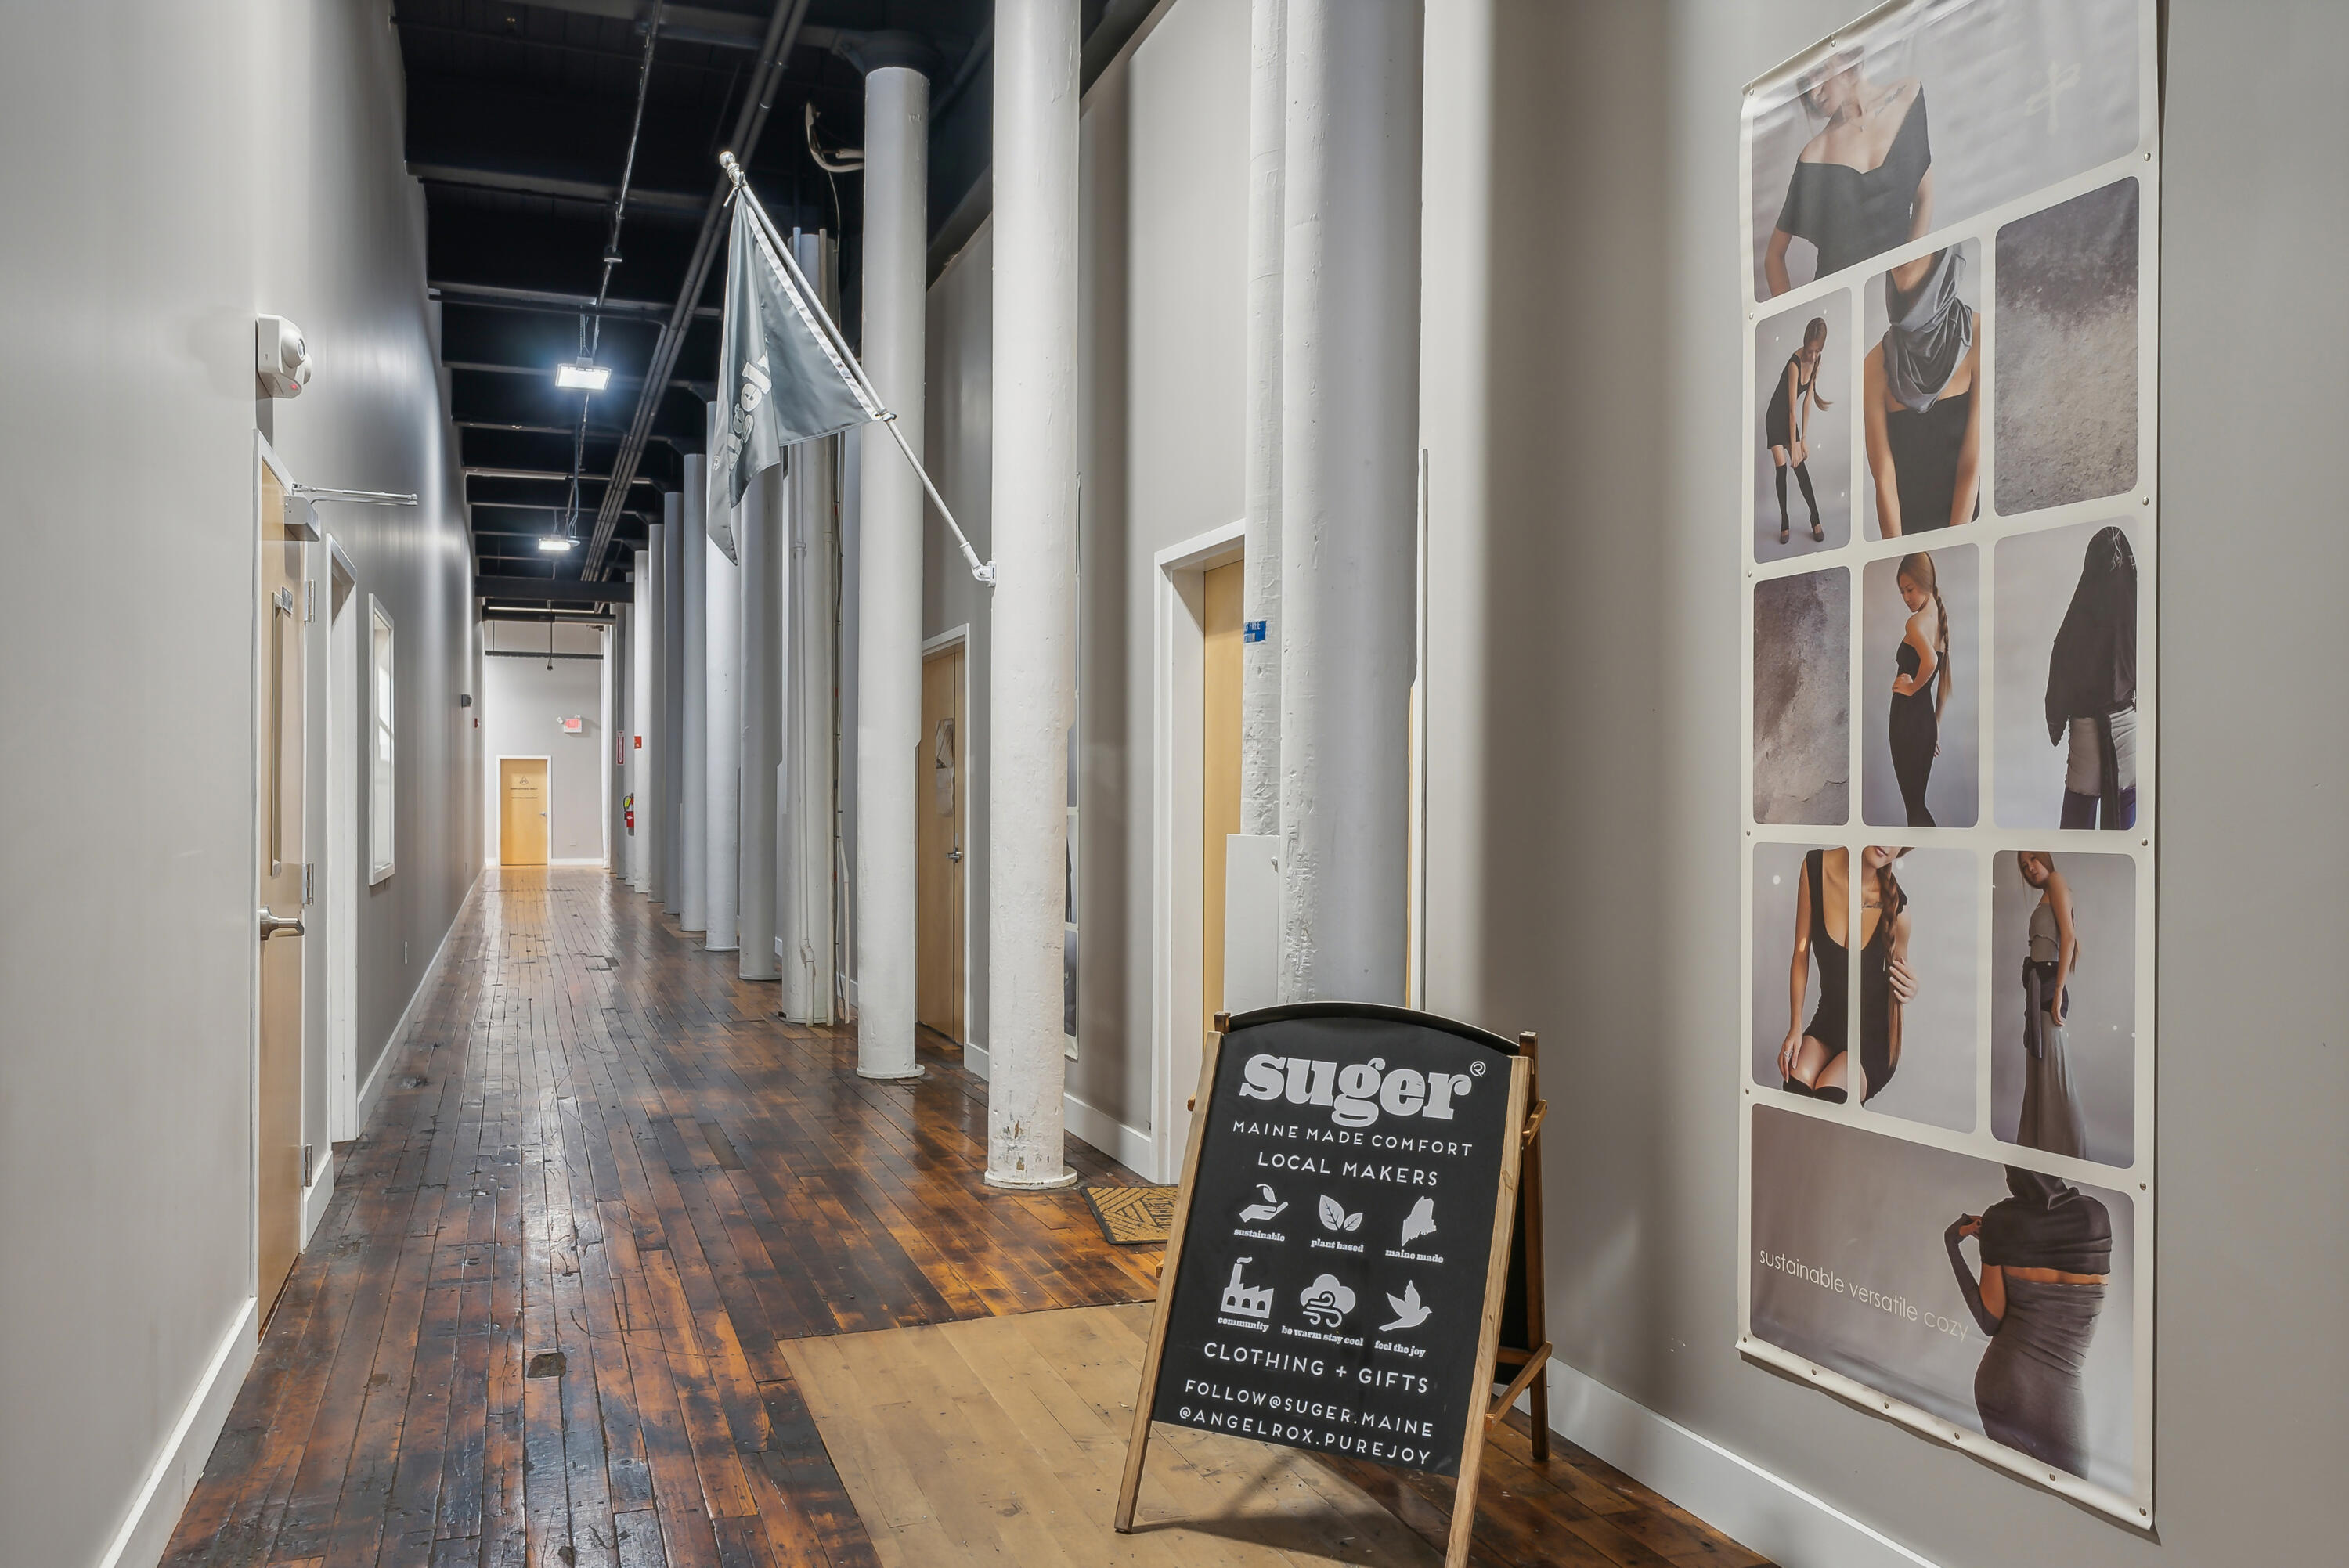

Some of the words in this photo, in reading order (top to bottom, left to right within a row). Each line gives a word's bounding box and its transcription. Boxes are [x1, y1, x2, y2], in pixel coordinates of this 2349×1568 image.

[1233, 1120, 1299, 1139] MAINE
[1306, 1128, 1364, 1145] MADE
[1371, 1134, 1473, 1157] COMFORT
[1258, 1152, 1330, 1174] LOCAL
[1342, 1162, 1438, 1186] MAKERS
[1234, 1228, 1286, 1242] sustainable
[1311, 1238, 1336, 1249] plant
[1337, 1241, 1364, 1253] based
[1385, 1249, 1416, 1260] maine
[1416, 1254, 1444, 1264] made
[1759, 1249, 1845, 1294] sustainable
[1849, 1282, 1918, 1321] versatile
[1924, 1311, 1968, 1343] cozy
[1217, 1317, 1270, 1333] community
[1281, 1325, 1294, 1336] be
[1294, 1329, 1322, 1340] warm
[1322, 1334, 1344, 1345] stay
[1344, 1337, 1364, 1346] cool
[1374, 1339, 1393, 1351] feel
[1393, 1343, 1409, 1354] the
[1409, 1346, 1427, 1358] joy
[1204, 1342, 1325, 1376] CLOTHING
[1358, 1368, 1428, 1394] GIFTS
[1179, 1406, 1431, 1465] @ANGELROX.PUREJOY
